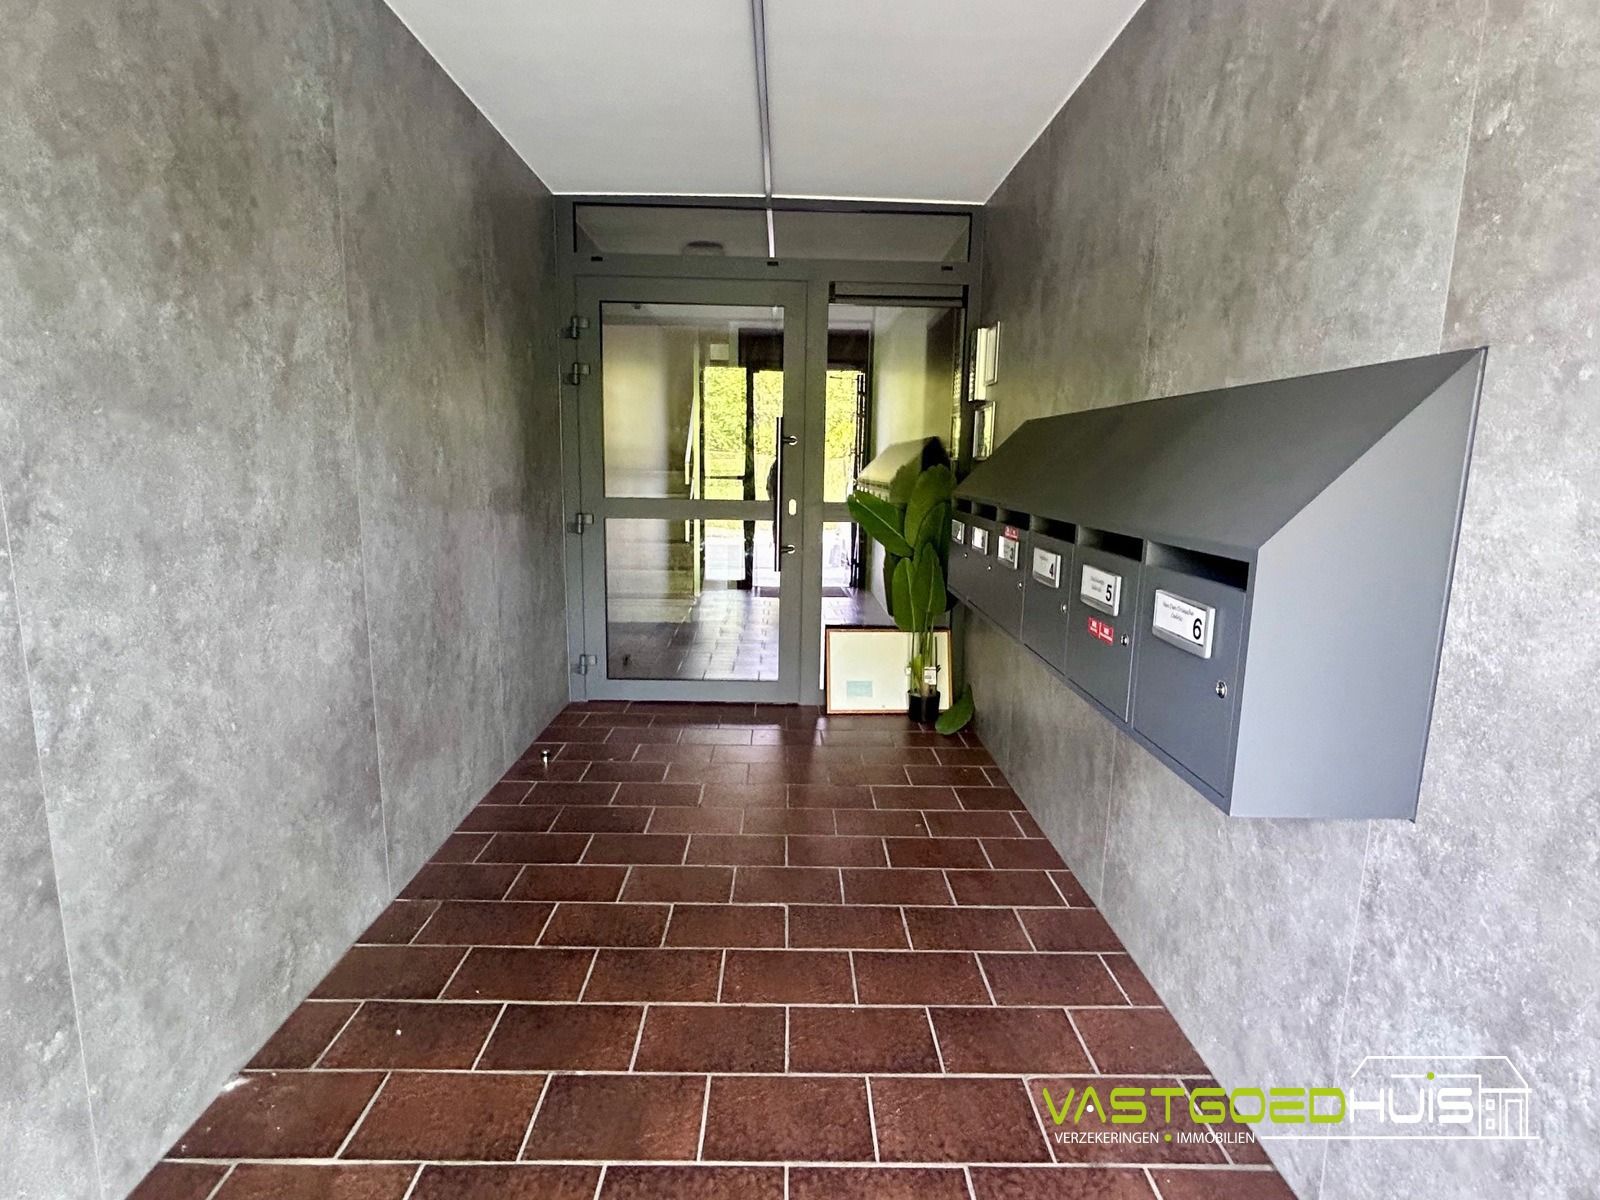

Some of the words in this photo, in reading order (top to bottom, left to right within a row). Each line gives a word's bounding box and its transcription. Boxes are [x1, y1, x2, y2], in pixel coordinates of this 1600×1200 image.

[1049, 563, 1054, 577] 4
[1105, 584, 1113, 602] 5
[1192, 617, 1203, 640] 6
